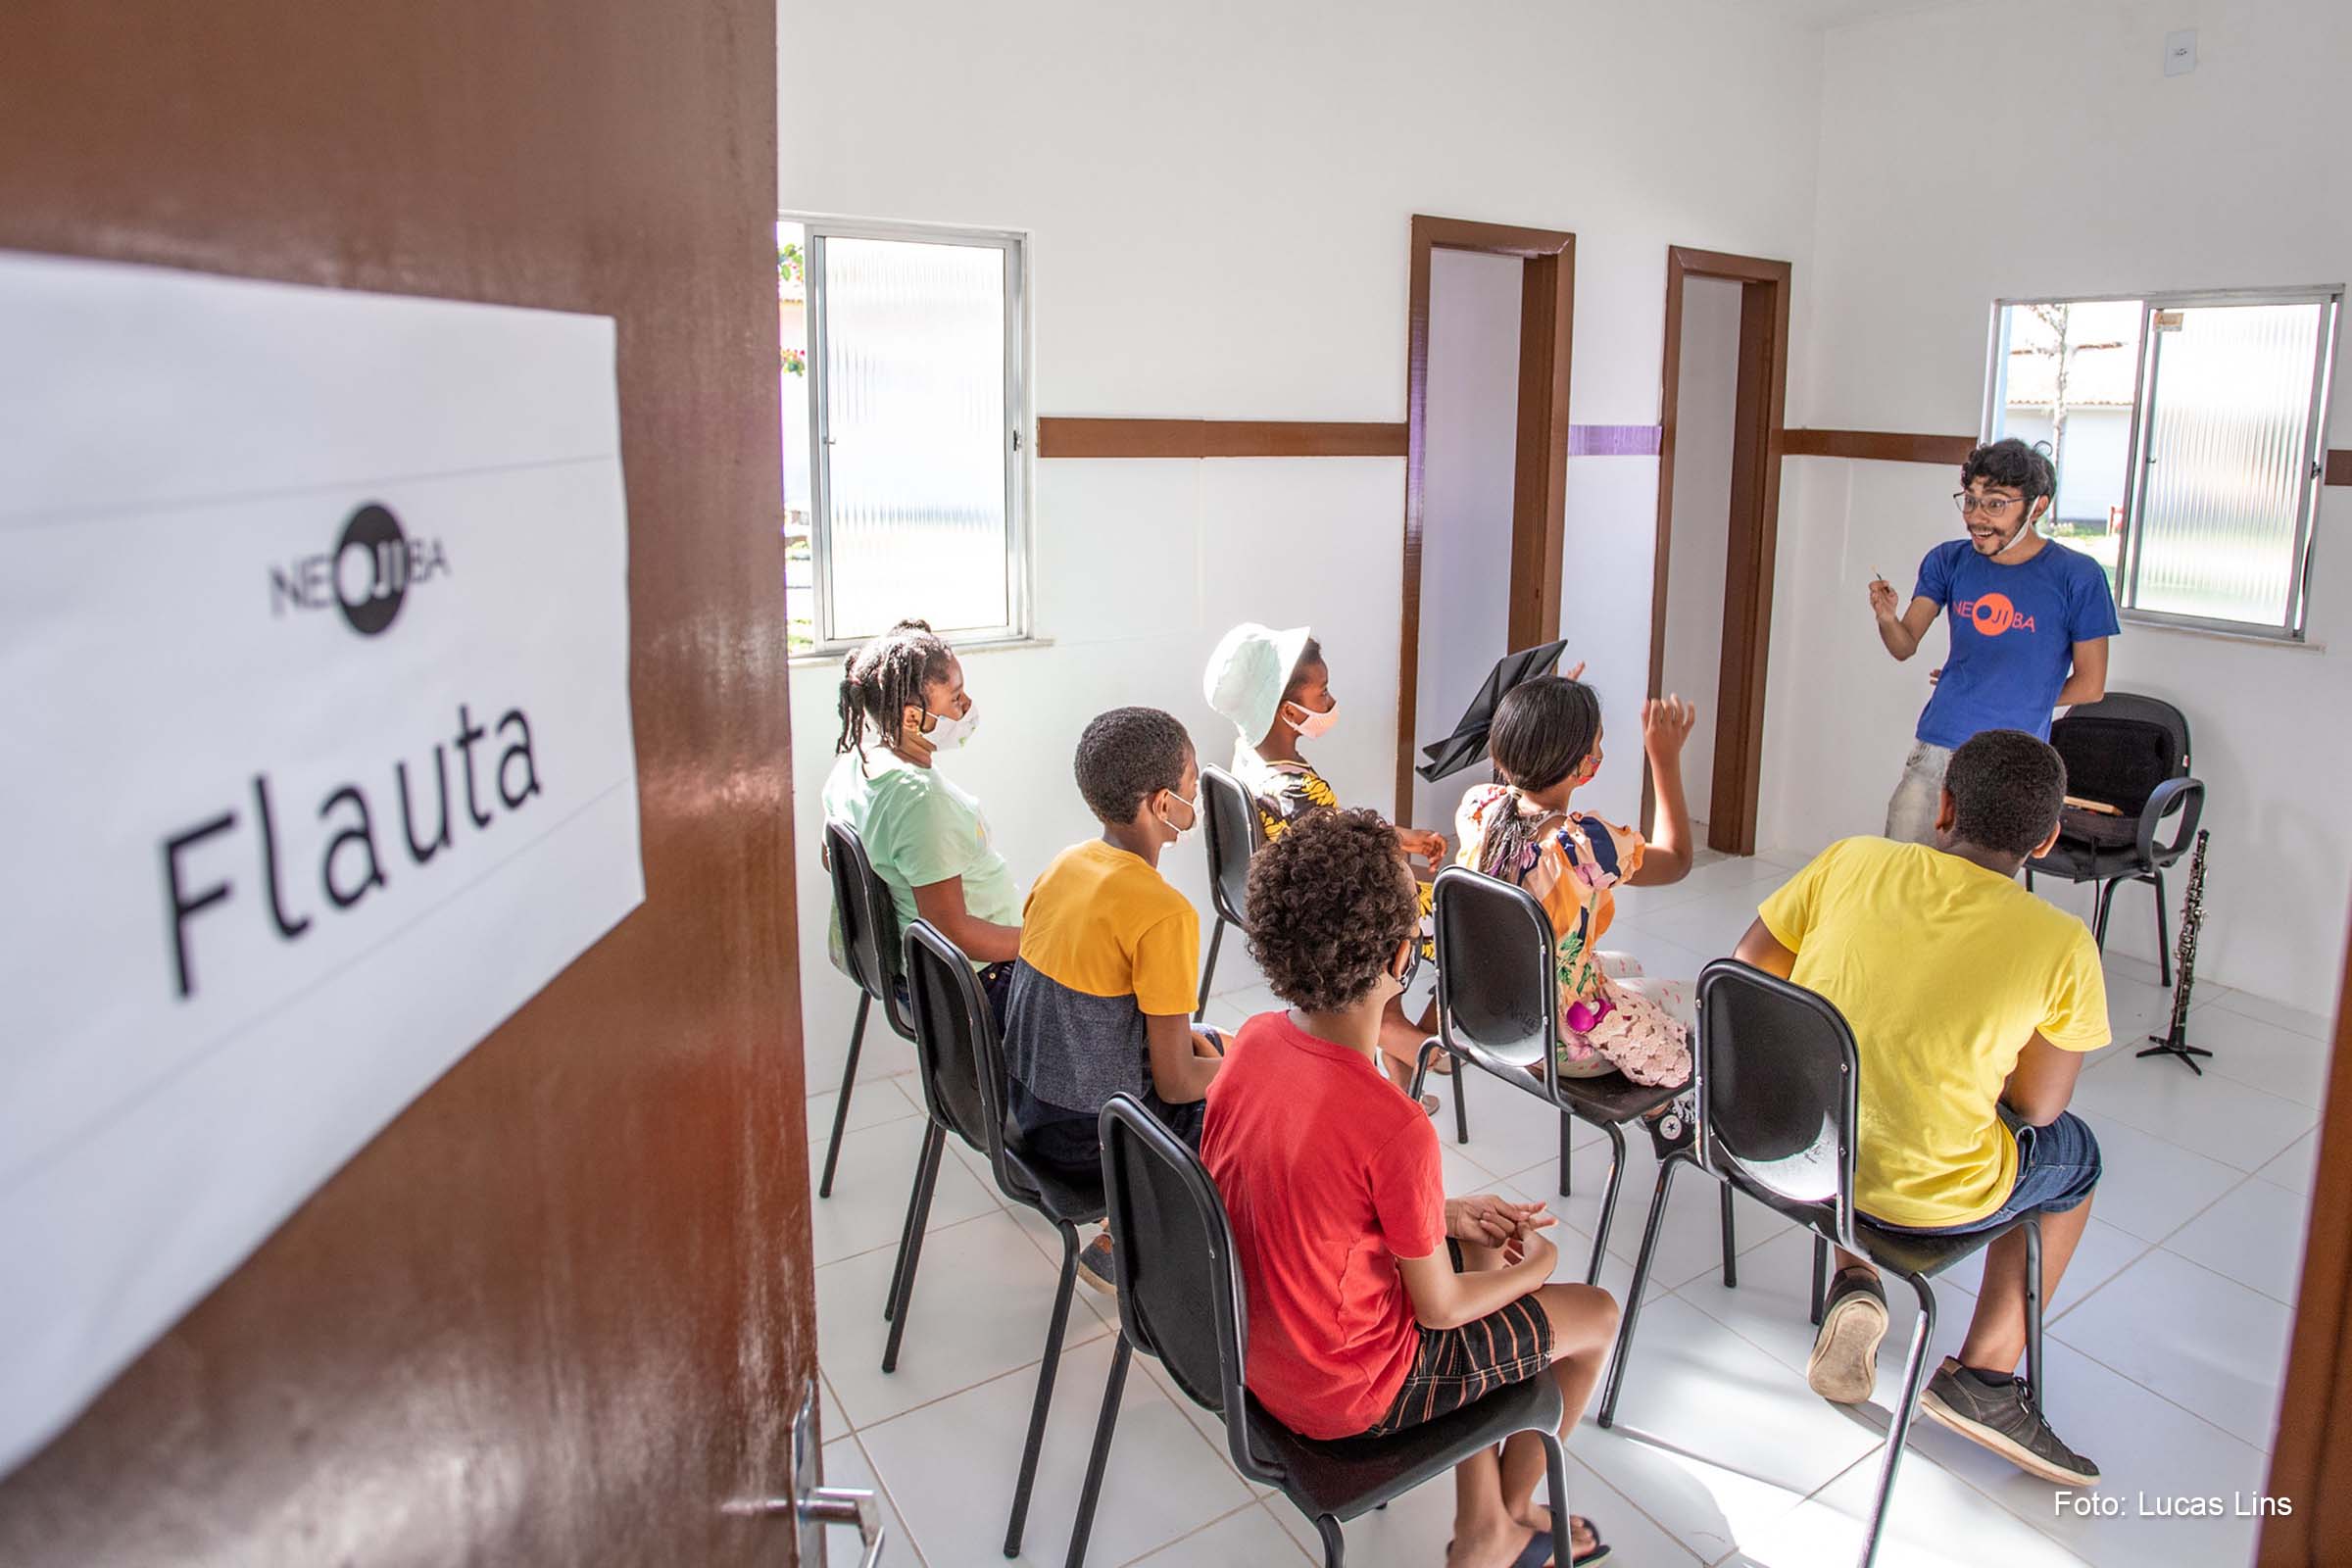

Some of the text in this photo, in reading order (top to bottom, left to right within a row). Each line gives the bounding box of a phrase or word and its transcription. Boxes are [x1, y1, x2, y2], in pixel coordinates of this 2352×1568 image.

[270, 536, 451, 618] NEOJIBA
[1952, 598, 2035, 634] NEOJIBA
[159, 704, 542, 999] Flauta
